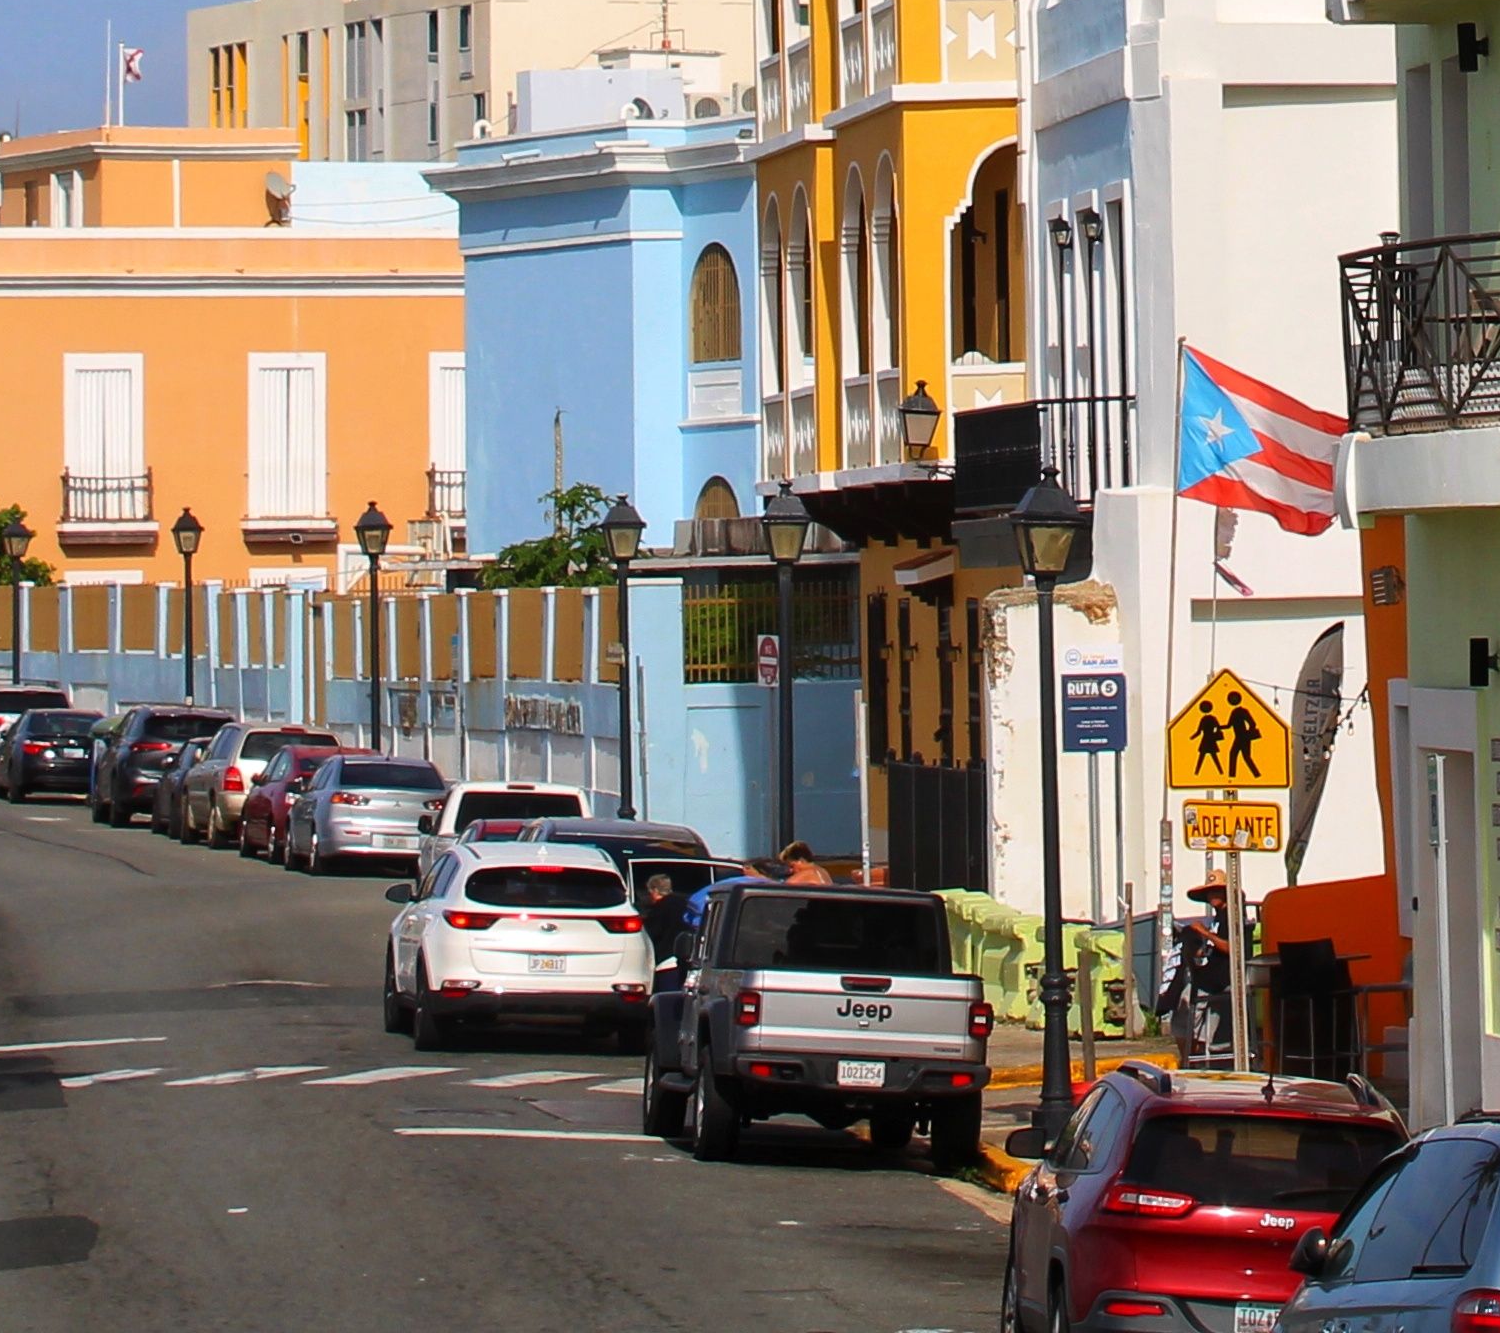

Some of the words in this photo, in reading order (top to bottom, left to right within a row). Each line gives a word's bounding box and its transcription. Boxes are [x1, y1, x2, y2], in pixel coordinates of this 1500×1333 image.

[1067, 681, 1099, 696] RUTA
[1303, 679, 1320, 744] SELTZER
[1190, 815, 1274, 839] ADELANTE
[837, 999, 892, 1022] Jeep
[1260, 1213, 1294, 1229] Jeep
